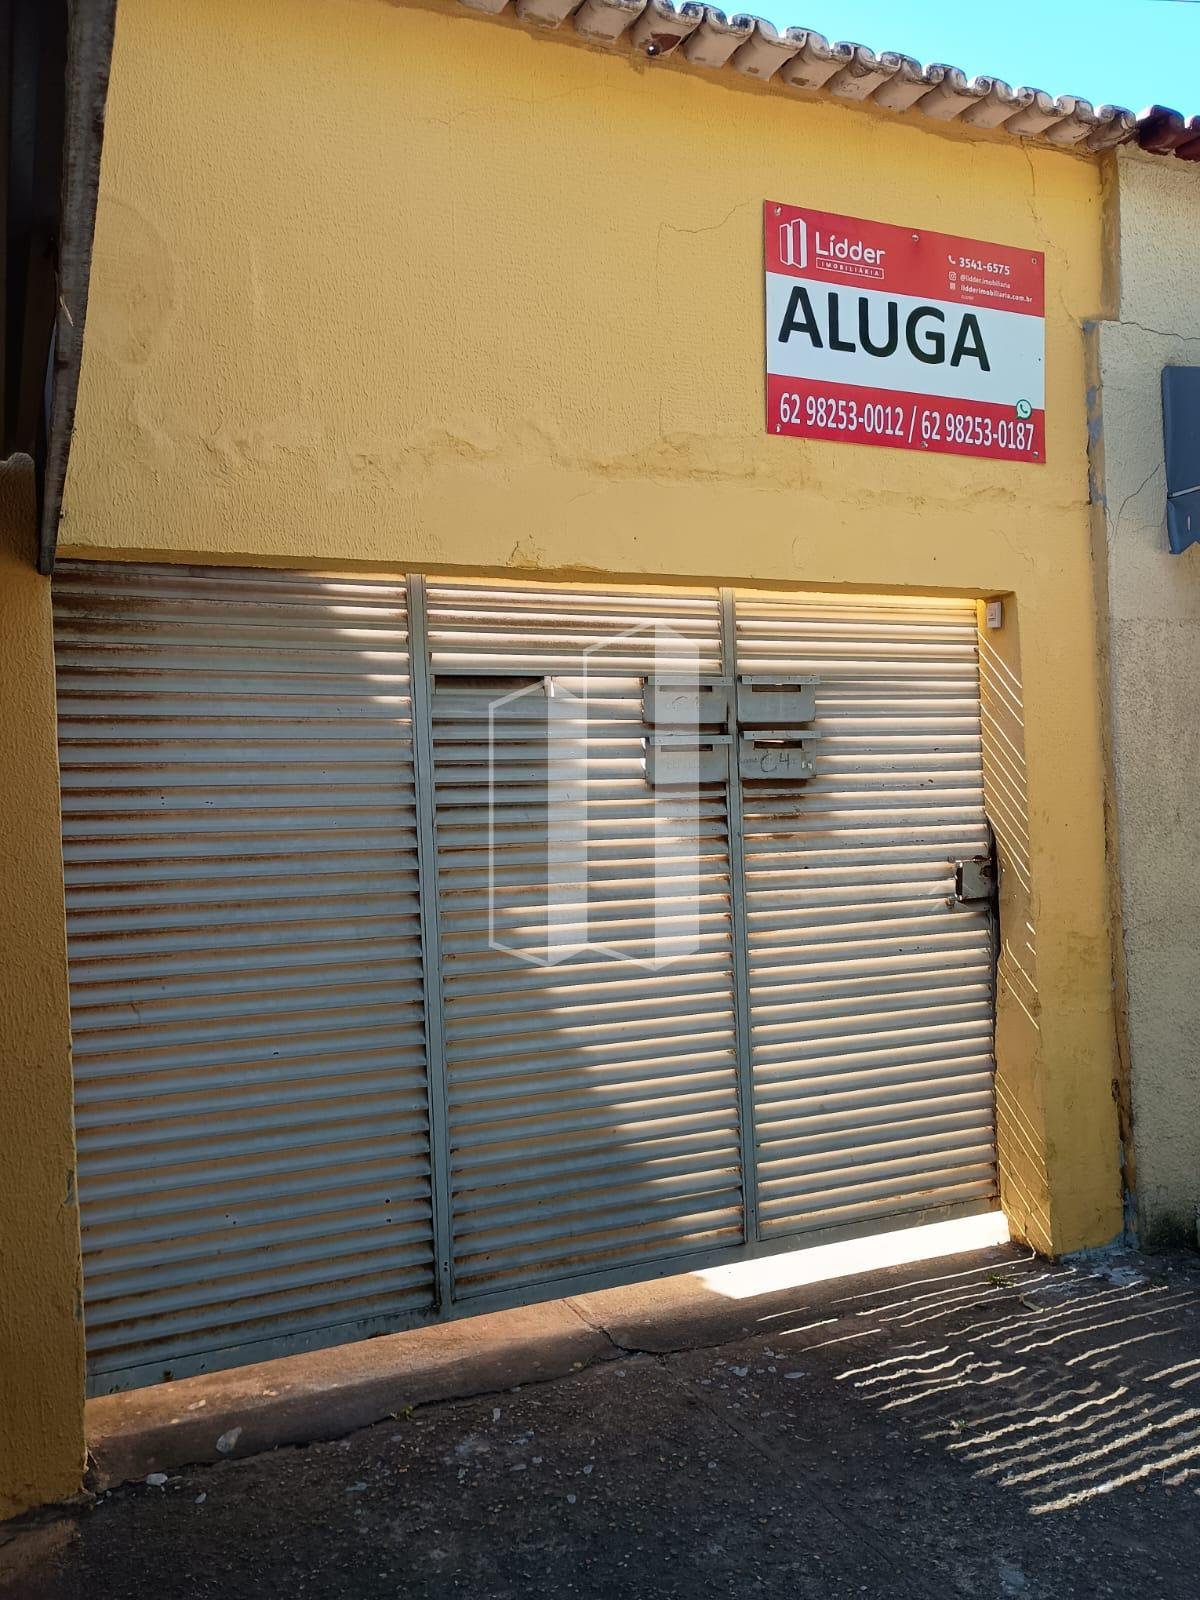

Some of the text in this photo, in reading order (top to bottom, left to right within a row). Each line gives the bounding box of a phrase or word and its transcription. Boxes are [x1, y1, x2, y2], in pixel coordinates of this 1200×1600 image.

[815, 231, 886, 265] Lídder
[959, 257, 1010, 276] 3541-6575
[778, 285, 991, 372] ALUGA
[780, 392, 801, 424] 62
[806, 395, 904, 436] 98253-0012
[921, 410, 941, 440] 62
[945, 412, 1034, 451] 98253-0187
